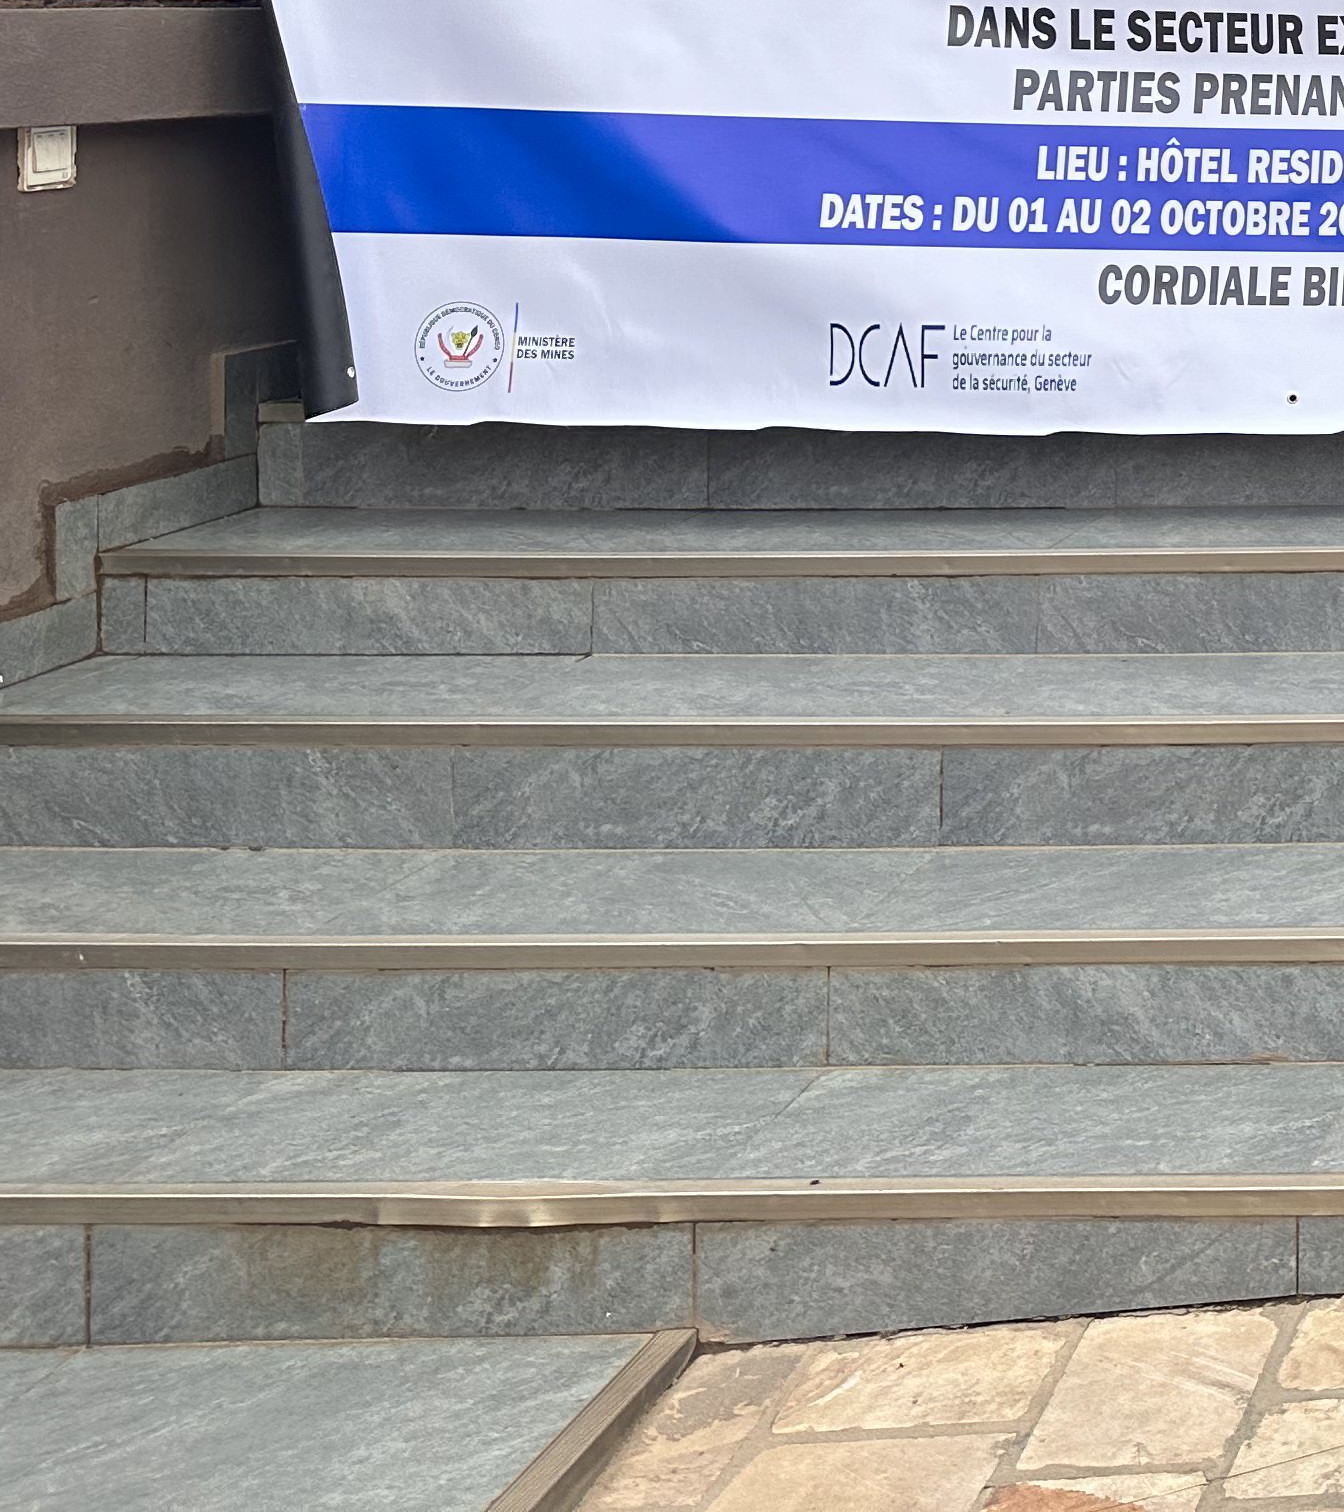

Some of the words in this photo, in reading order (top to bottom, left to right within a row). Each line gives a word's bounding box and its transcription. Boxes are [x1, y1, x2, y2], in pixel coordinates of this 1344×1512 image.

[947, 4, 1057, 49] DANS
[1070, 8, 1115, 51] LE
[1127, 10, 1304, 55] SECTEUR
[1013, 68, 1181, 114] PARTIES
[1036, 145, 1110, 182] LIEU
[1118, 154, 1128, 182] :
[1136, 136, 1238, 184] HÔTEL
[819, 193, 925, 232] DATES
[932, 202, 943, 232] :
[952, 196, 999, 233] DU
[1008, 197, 1049, 233] 01
[1056, 198, 1102, 235] AU
[1111, 199, 1151, 235] 02
[1160, 199, 1311, 236] OCTOBRE
[1098, 264, 1292, 307] CORDIALE
[517, 334, 576, 348] MINISTÈRE
[953, 325, 967, 341] Le
[970, 324, 1008, 342] Centre
[1010, 327, 1039, 345] pour
[1042, 324, 1052, 342] la
[516, 349, 538, 359] DES
[540, 349, 575, 360] MINES
[829, 322, 946, 388] DCAF
[952, 351, 1026, 370] gouvernance
[1030, 350, 1045, 367] du
[1048, 350, 1092, 367] secteur
[426, 366, 435, 376] LE
[952, 374, 966, 391] de
[969, 374, 980, 391] la
[982, 374, 1031, 394] sécurité,
[1034, 374, 1077, 392] Genève
